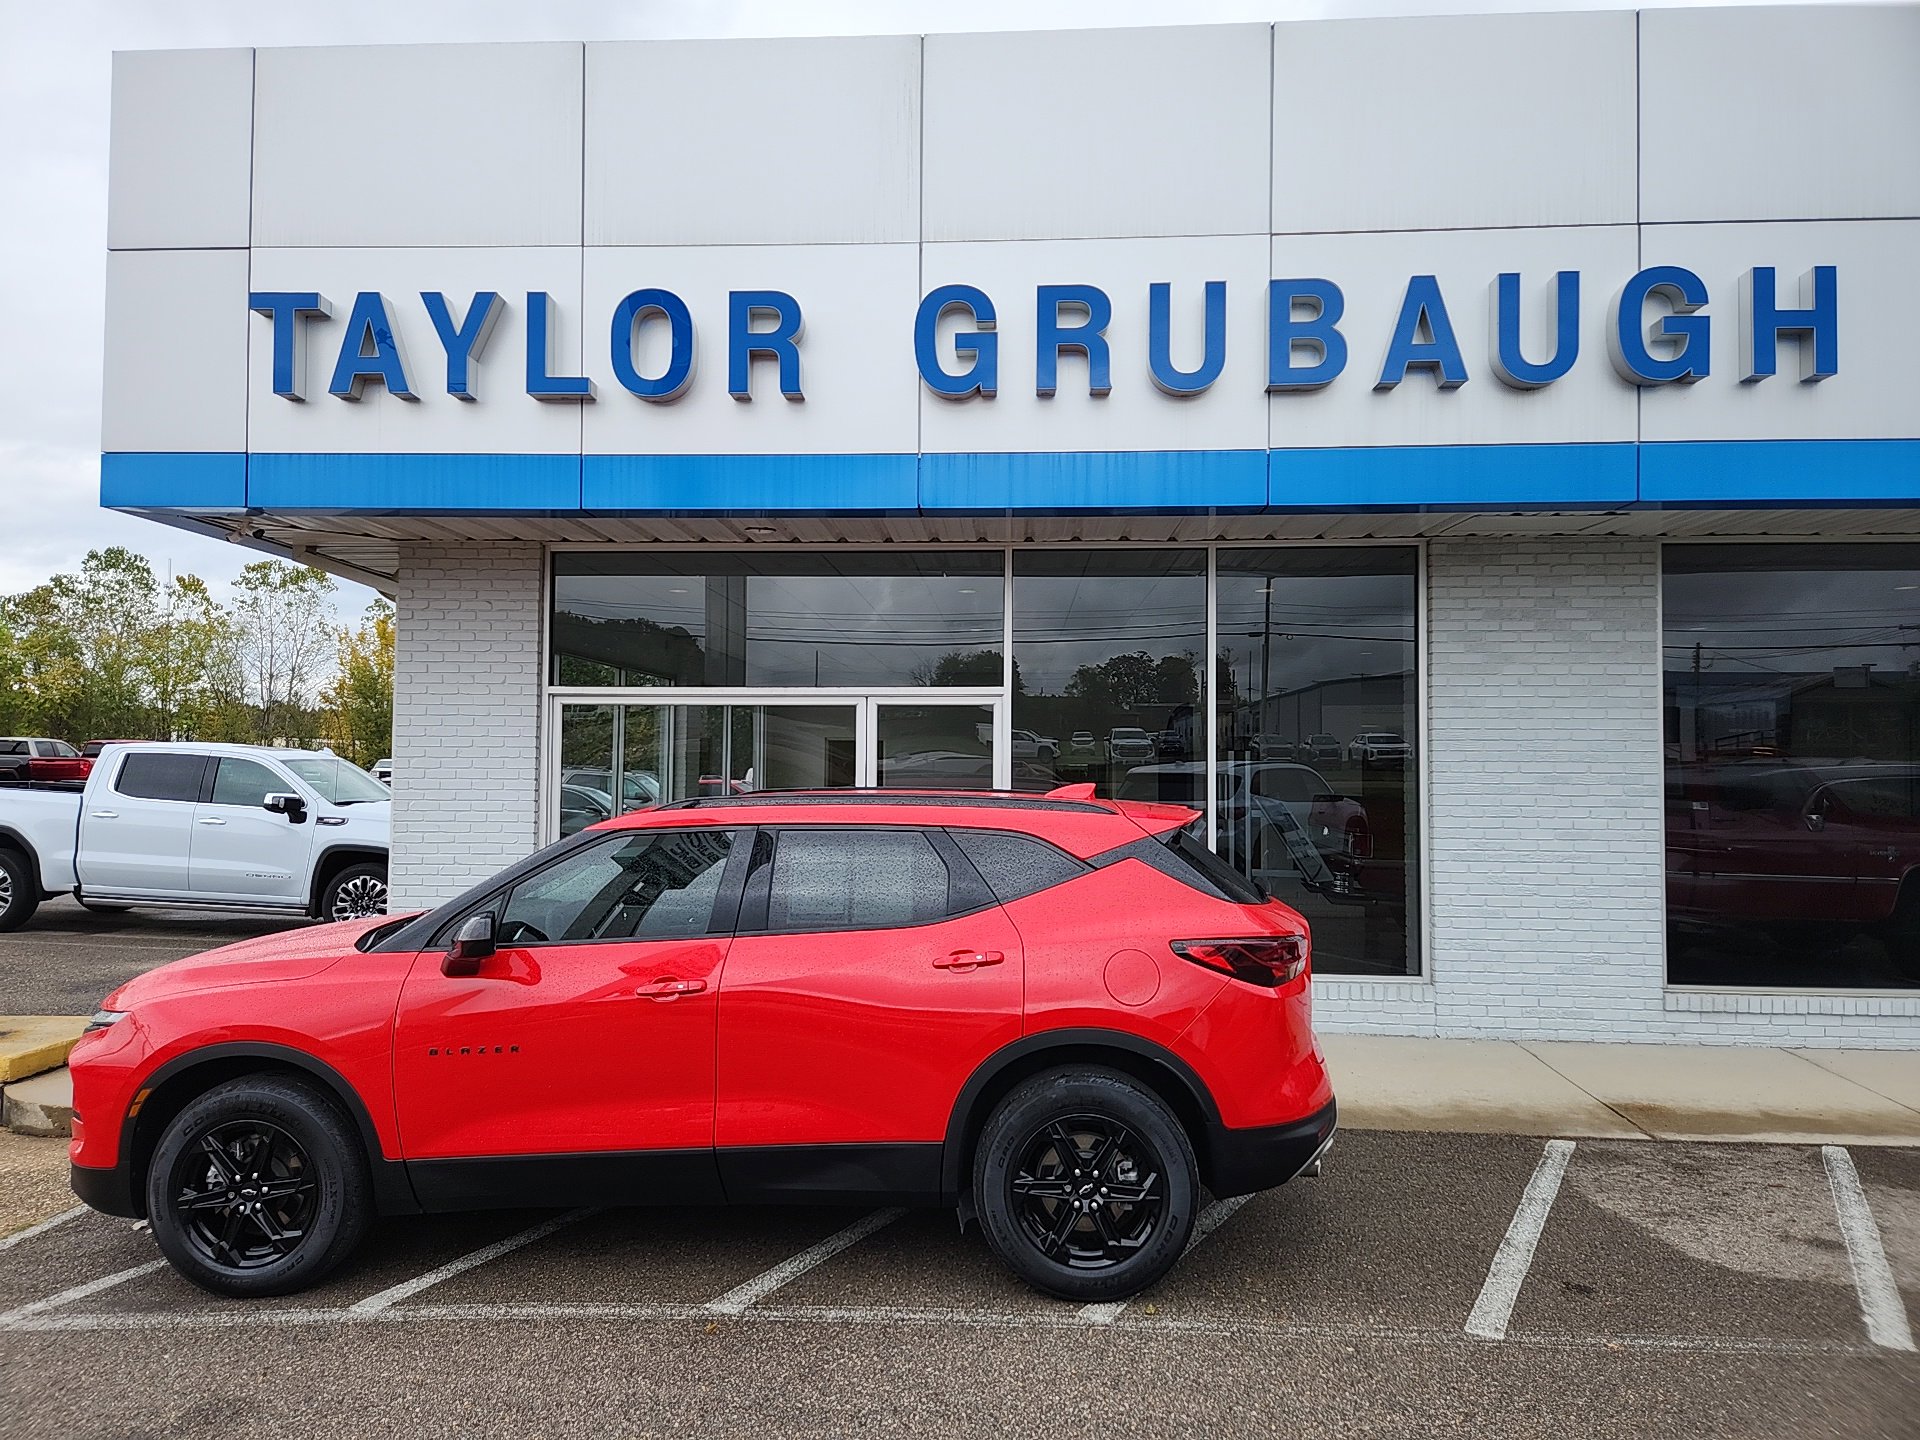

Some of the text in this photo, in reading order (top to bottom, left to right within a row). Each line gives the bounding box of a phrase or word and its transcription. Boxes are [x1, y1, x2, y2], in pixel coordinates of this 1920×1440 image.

[250, 265, 1838, 400] TAYLOR GRUBAUGH
[428, 1045, 520, 1056] BLAZER
